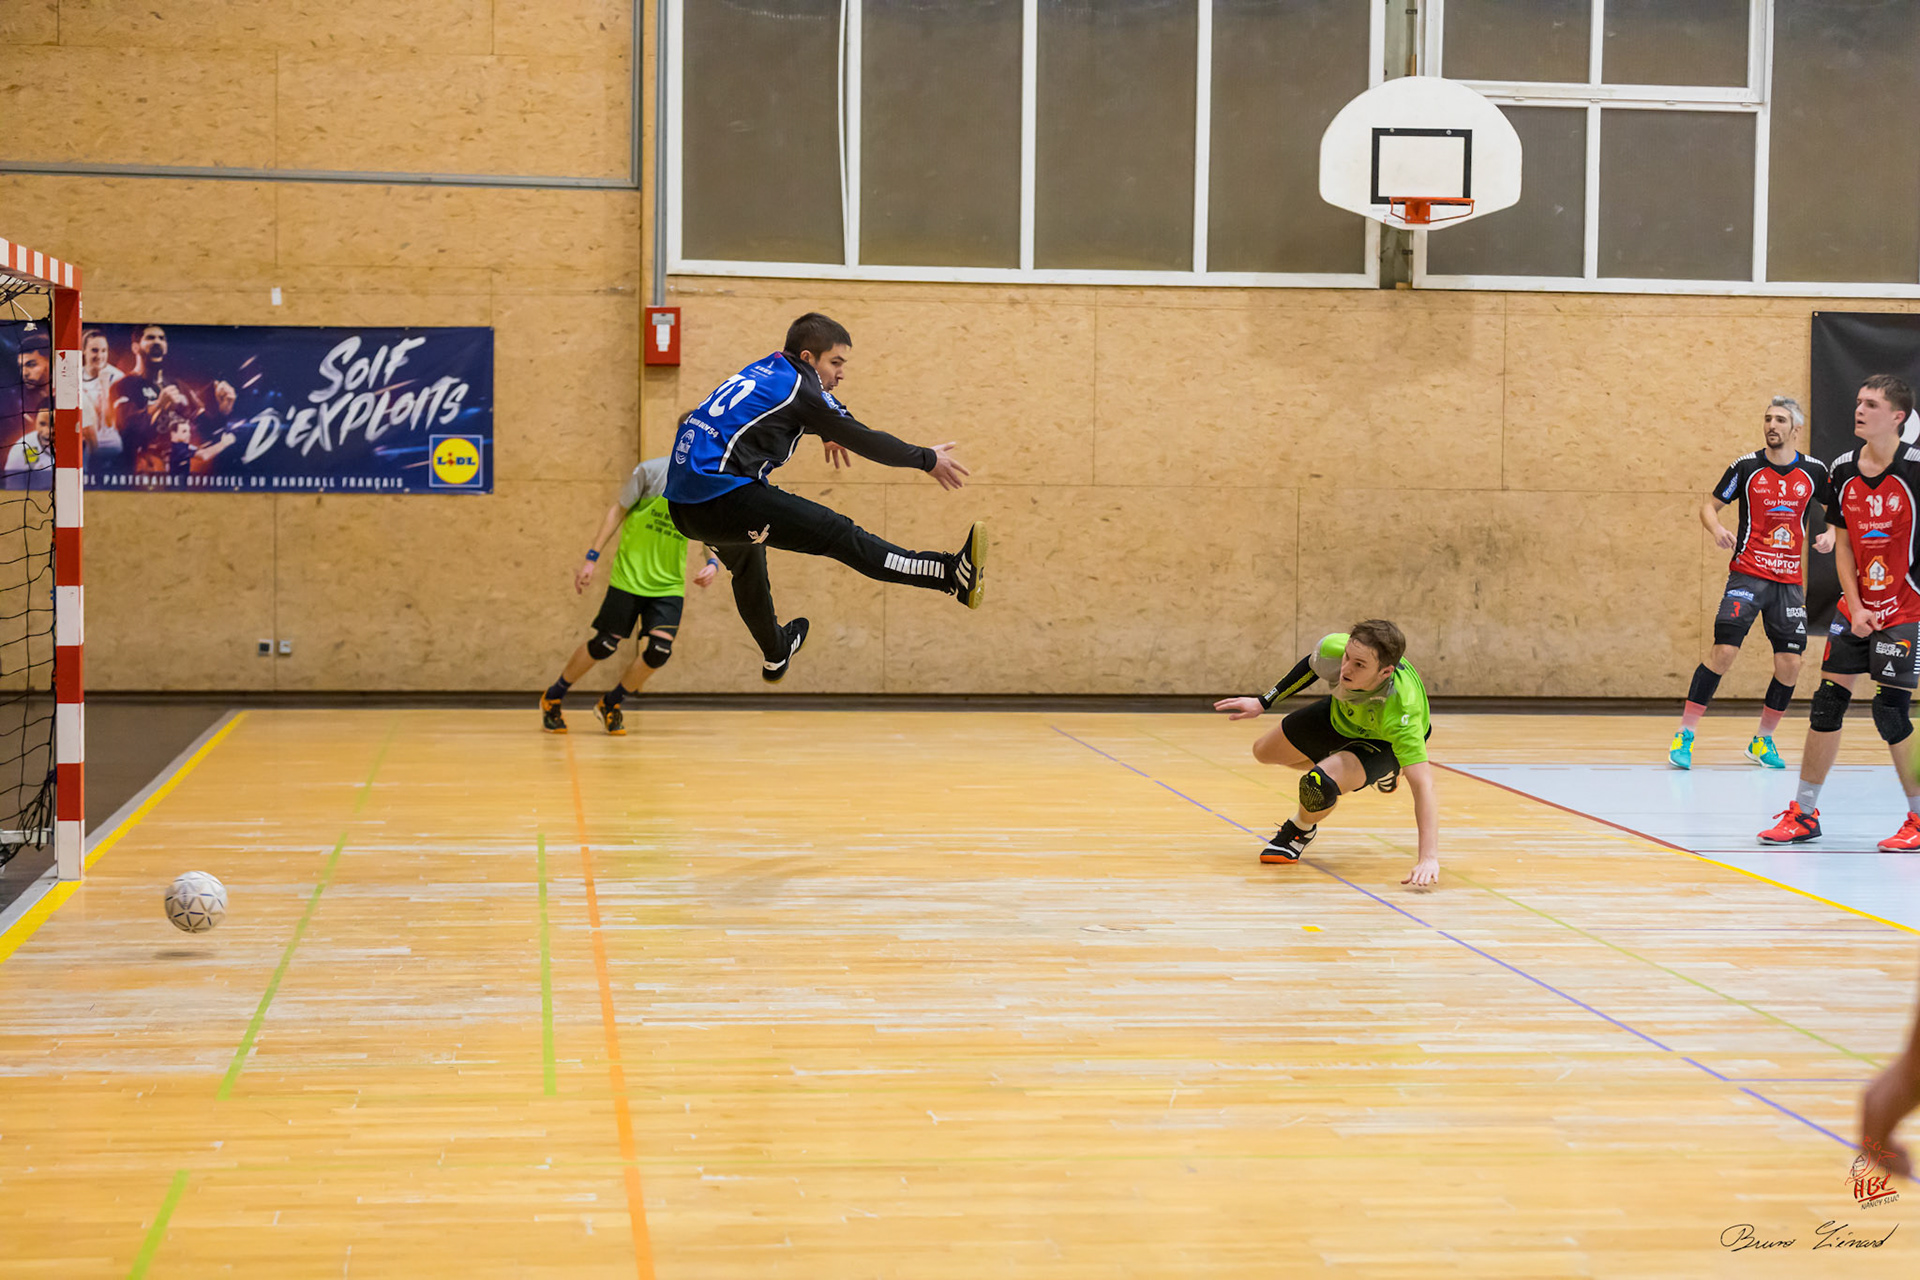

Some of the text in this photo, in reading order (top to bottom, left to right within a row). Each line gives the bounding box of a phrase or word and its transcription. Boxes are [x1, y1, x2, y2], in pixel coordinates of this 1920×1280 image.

[240, 375, 470, 465] D'EXPLOITS
[103, 474, 180, 487] PARTENAIRE
[186, 475, 243, 487] OFFICIEL
[250, 476, 266, 488] DU
[272, 476, 335, 488] HANDBALL
[342, 476, 403, 491] FRANÇAIS
[1778, 479, 1787, 498] 3
[1763, 498, 1776, 507] Guy
[1865, 494, 1884, 518] 18
[1730, 601, 1741, 618] 3
